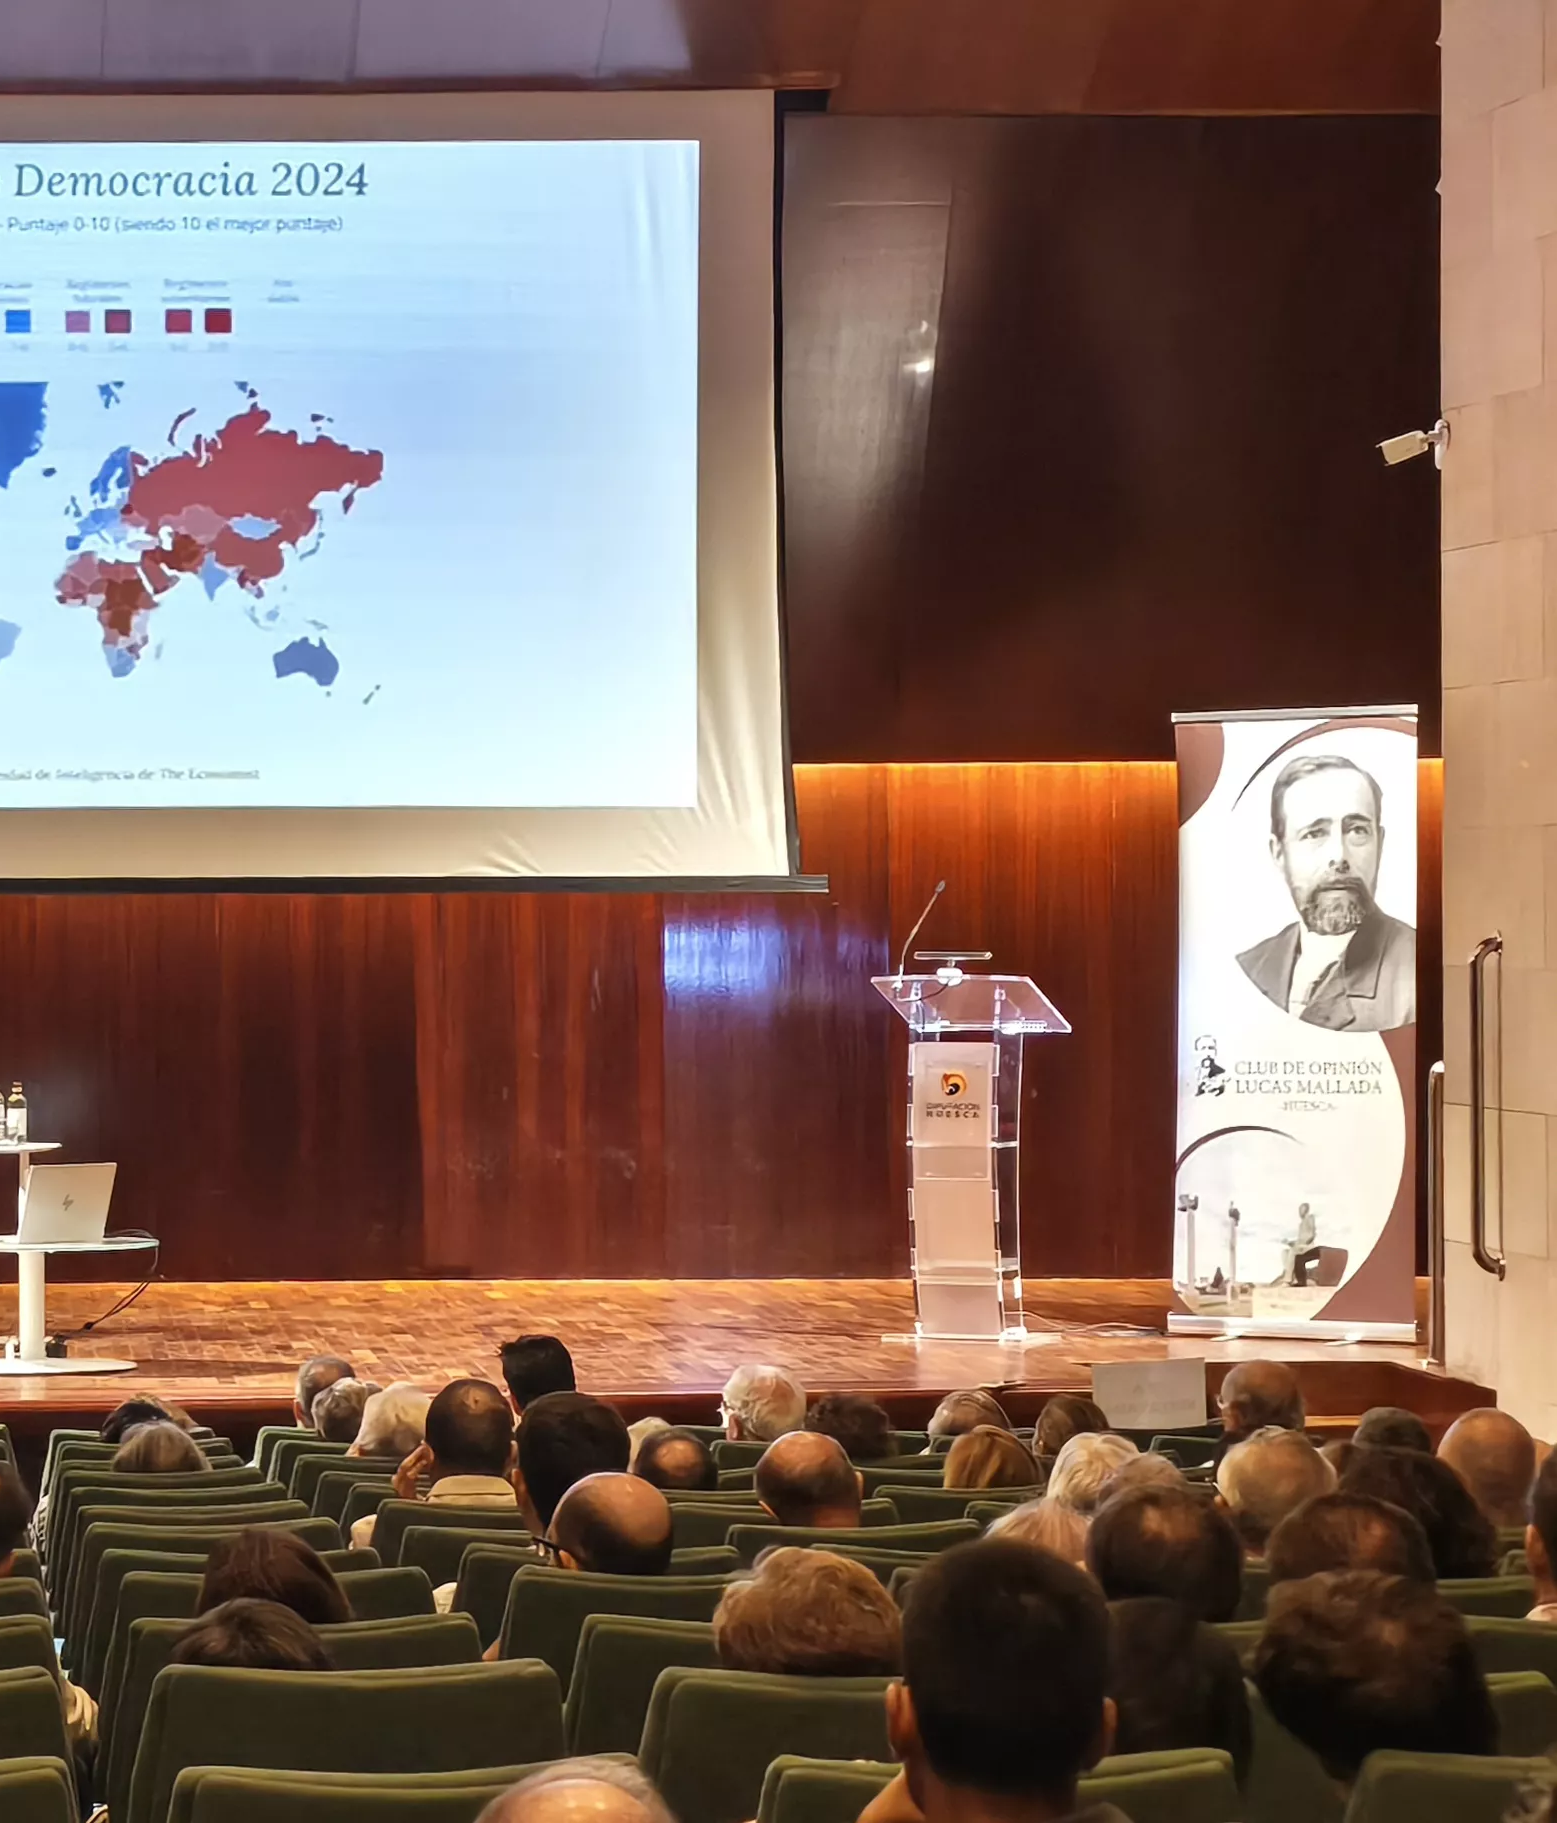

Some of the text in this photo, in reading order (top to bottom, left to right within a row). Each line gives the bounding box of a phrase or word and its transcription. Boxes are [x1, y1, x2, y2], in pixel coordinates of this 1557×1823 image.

[13, 161, 258, 198] Democracia
[271, 162, 369, 197] 2024
[7, 217, 69, 235] Puntaje
[74, 216, 111, 230] 0-10
[182, 216, 201, 230] 10
[206, 216, 220, 230] el
[1234, 1057, 1382, 1075] CLUB DE OPINIÓN
[1235, 1079, 1383, 1094] LUCAS MALLADA
